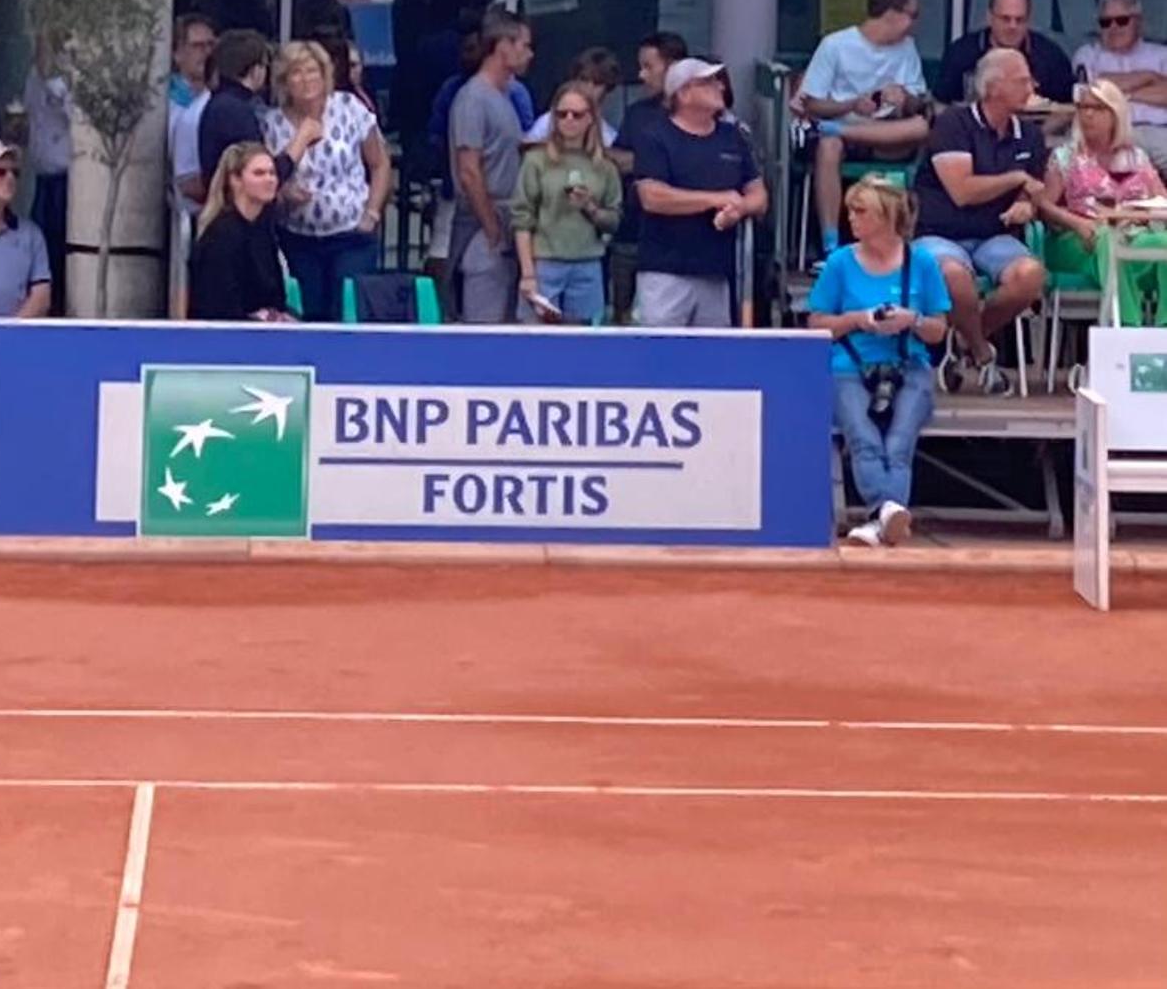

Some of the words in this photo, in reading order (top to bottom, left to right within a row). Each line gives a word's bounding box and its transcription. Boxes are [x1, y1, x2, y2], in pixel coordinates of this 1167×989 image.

[335, 396, 450, 445] BNP
[465, 398, 703, 449] PARIBAS
[422, 472, 610, 517] FORTIS
